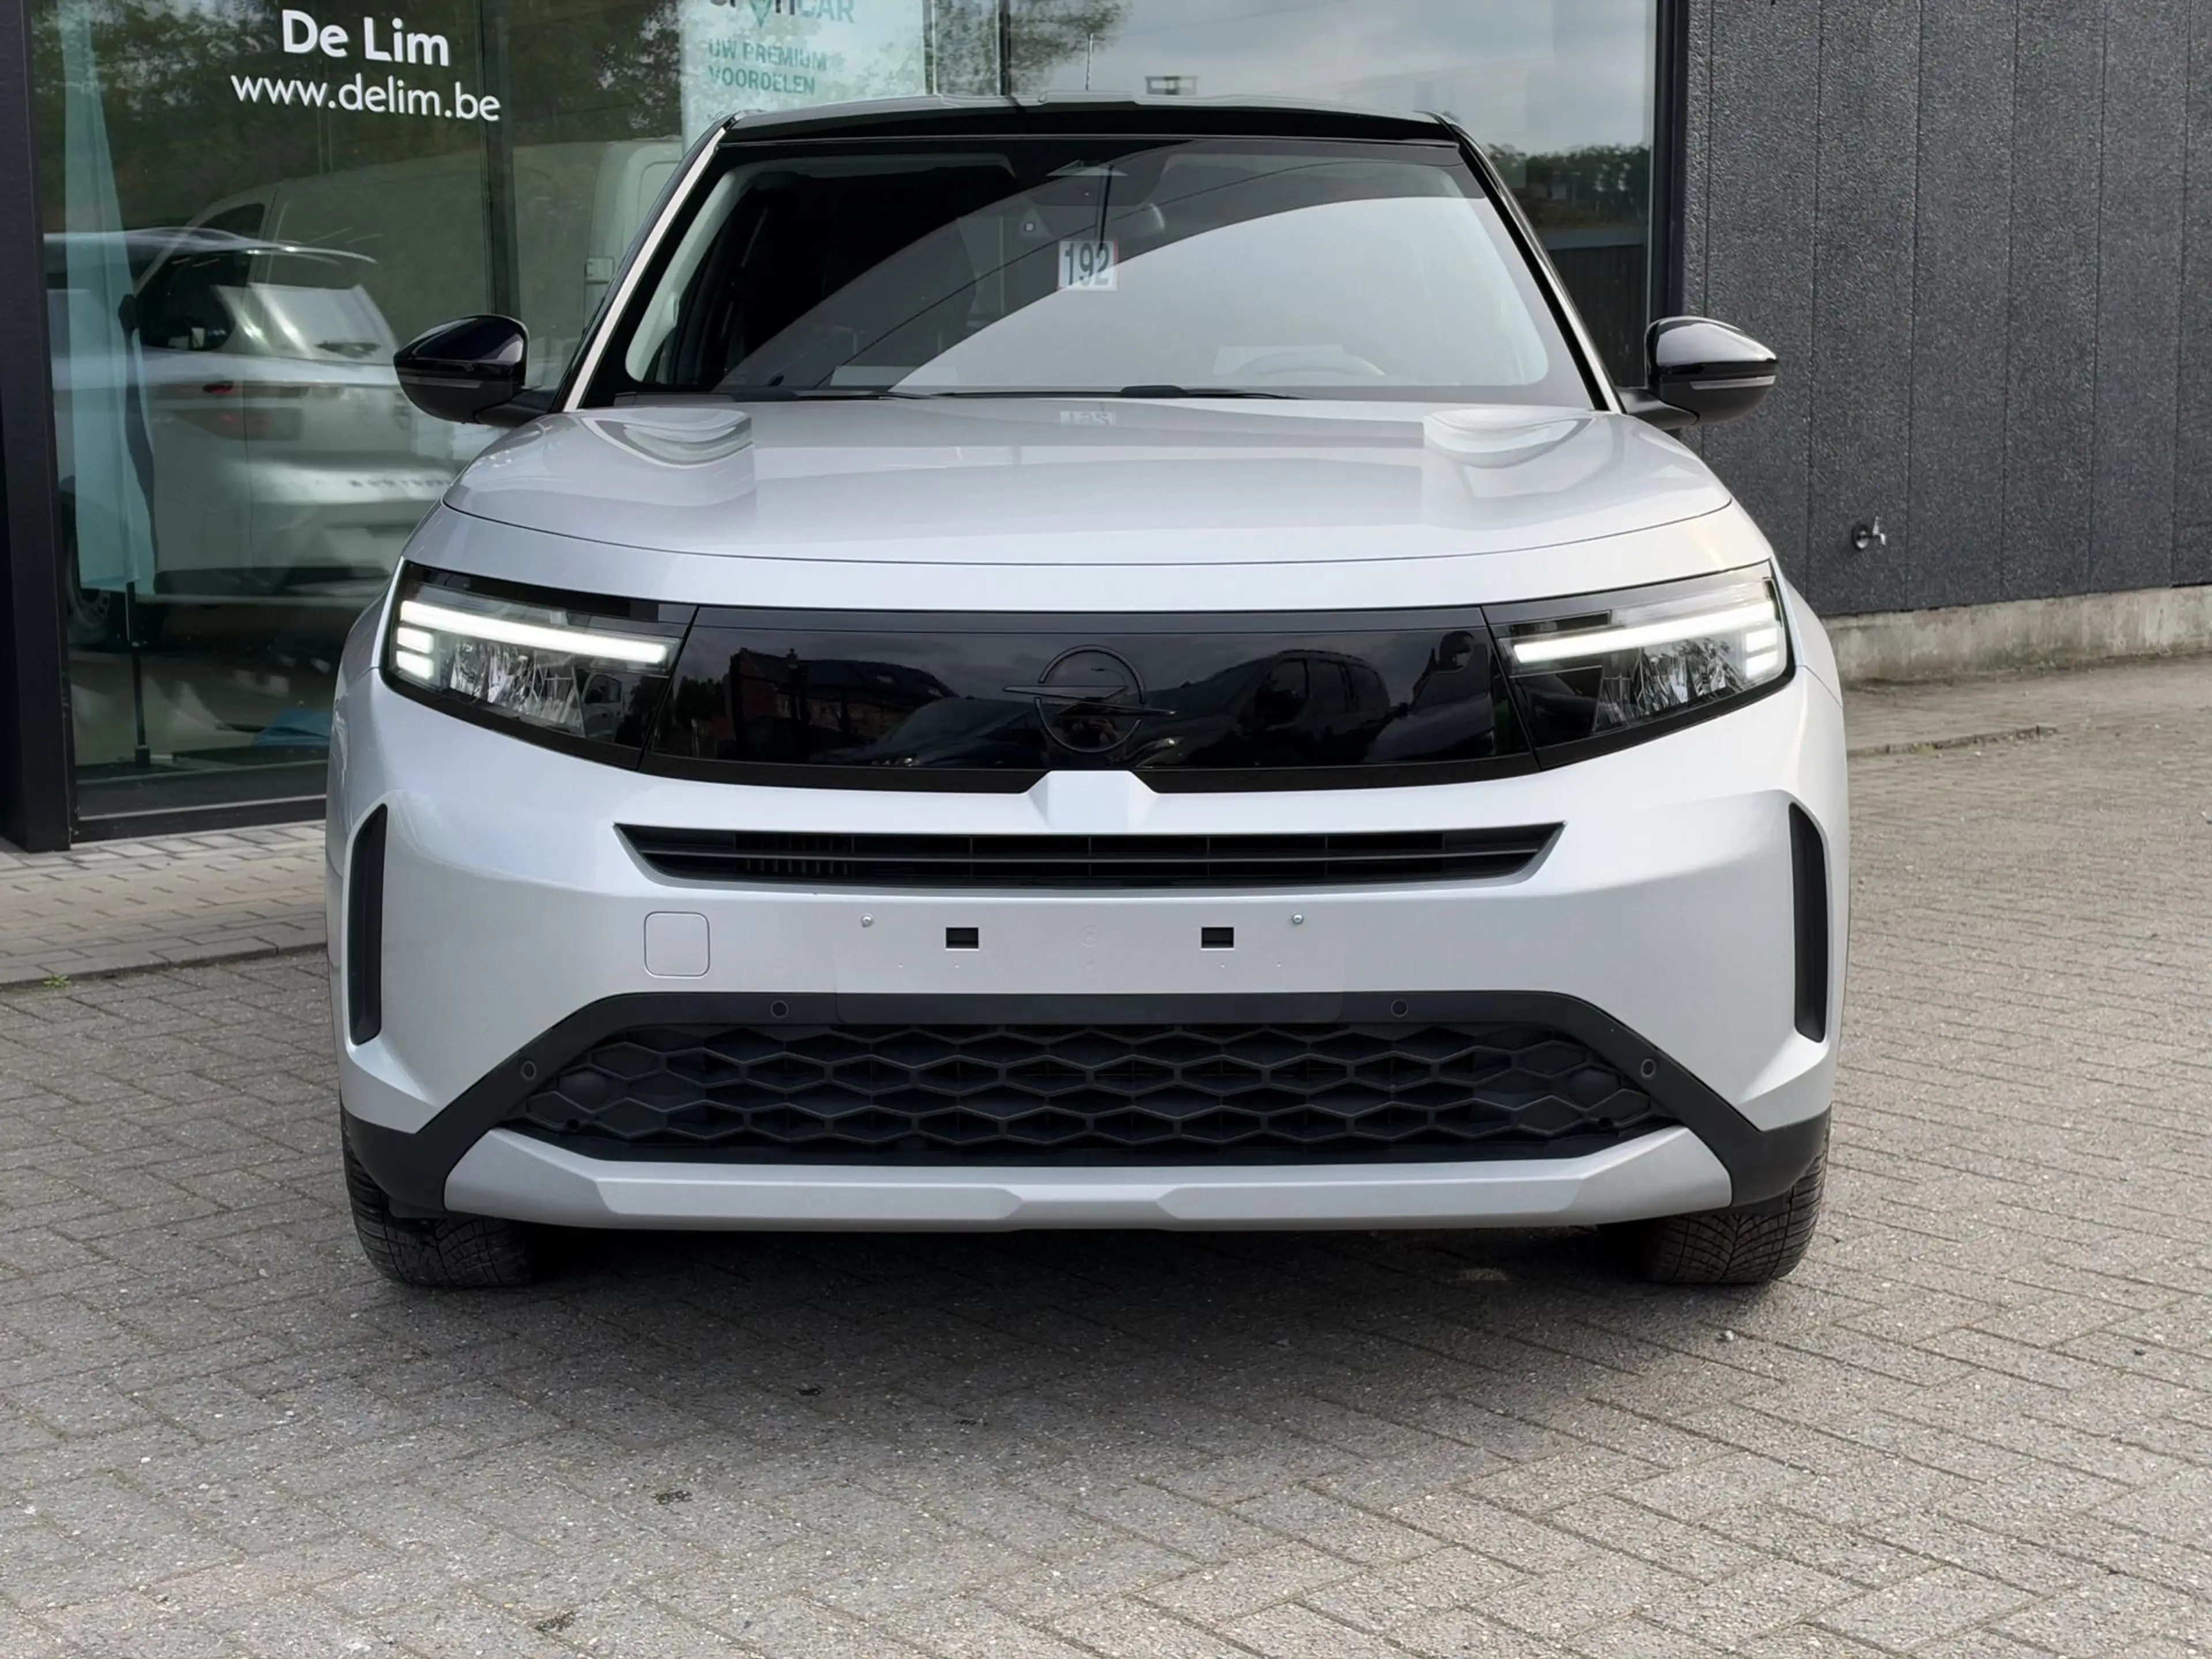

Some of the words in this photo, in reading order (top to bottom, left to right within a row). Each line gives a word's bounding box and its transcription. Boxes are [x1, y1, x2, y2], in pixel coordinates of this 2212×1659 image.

[710, 0, 854, 27] ICAR
[282, 9, 349, 57] De
[363, 17, 449, 66] Lim
[709, 39, 737, 60] UW
[743, 41, 827, 71] PREMIUM
[230, 73, 500, 121] www.delim.be
[709, 64, 815, 94] VOORDELEN
[1064, 243, 1109, 286] 192
